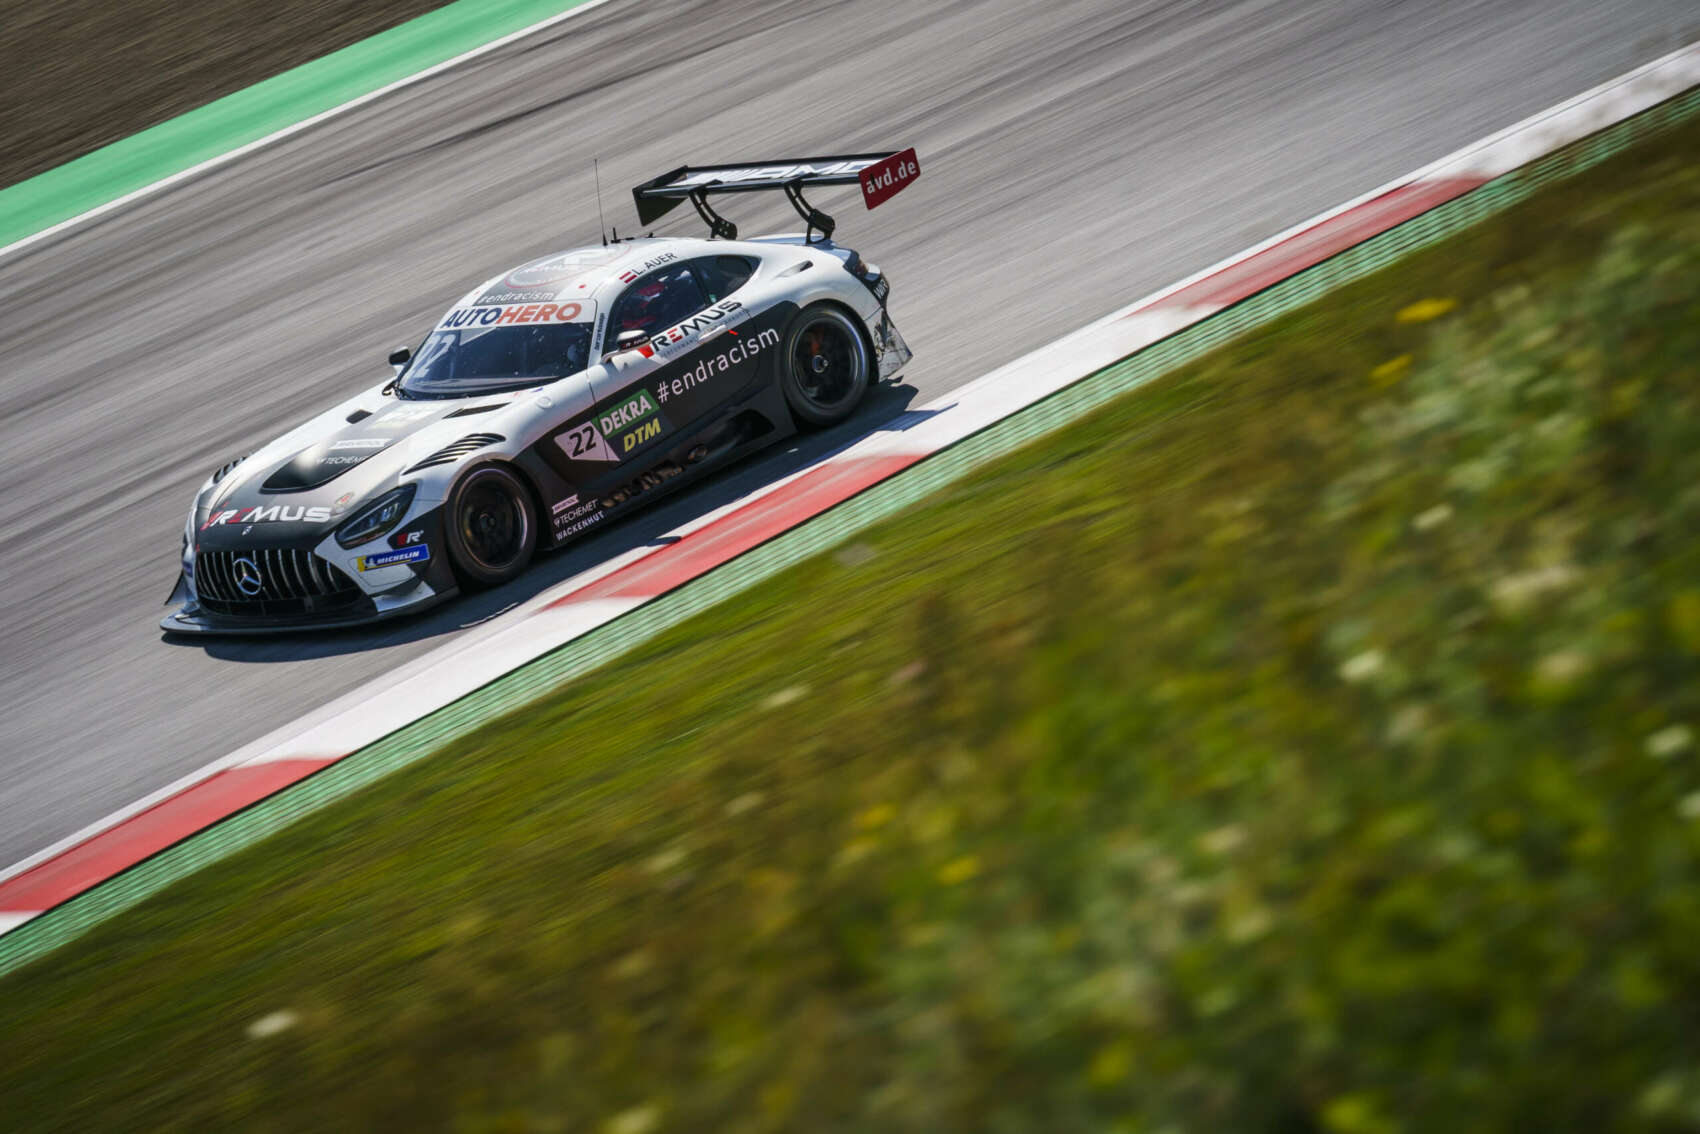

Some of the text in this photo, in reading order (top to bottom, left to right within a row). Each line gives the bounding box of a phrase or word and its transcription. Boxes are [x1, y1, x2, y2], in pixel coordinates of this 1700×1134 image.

[866, 158, 917, 194] avd.de
[441, 303, 582, 328] AUTOHERO
[651, 301, 742, 351] REMUS
[657, 328, 780, 403] #endracism
[600, 395, 652, 435] DEKRA
[569, 426, 597, 457] 22
[623, 418, 661, 452] DTM
[208, 506, 333, 527] REMUS
[556, 510, 604, 541] WACKENHUT
[377, 551, 420, 563] MICHELIN
